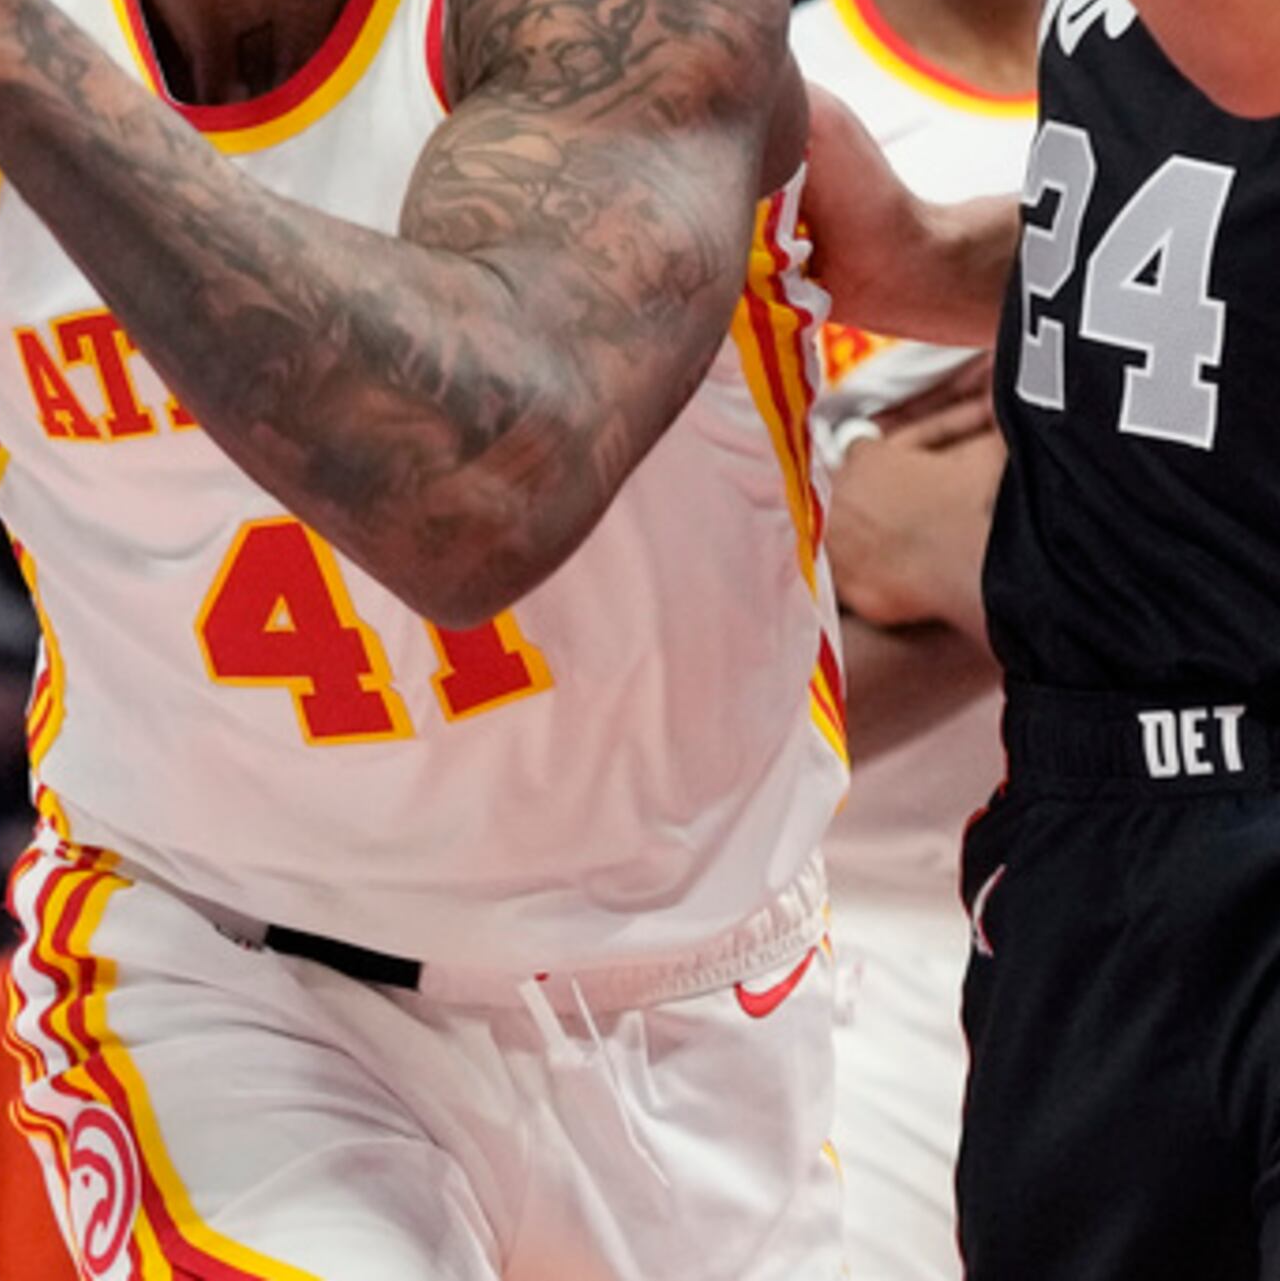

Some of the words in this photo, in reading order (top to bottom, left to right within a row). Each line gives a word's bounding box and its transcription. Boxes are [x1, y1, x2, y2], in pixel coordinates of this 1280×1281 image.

[1015, 120, 1236, 450] 24
[12, 305, 202, 444] AT
[1137, 705, 1247, 779] DET
